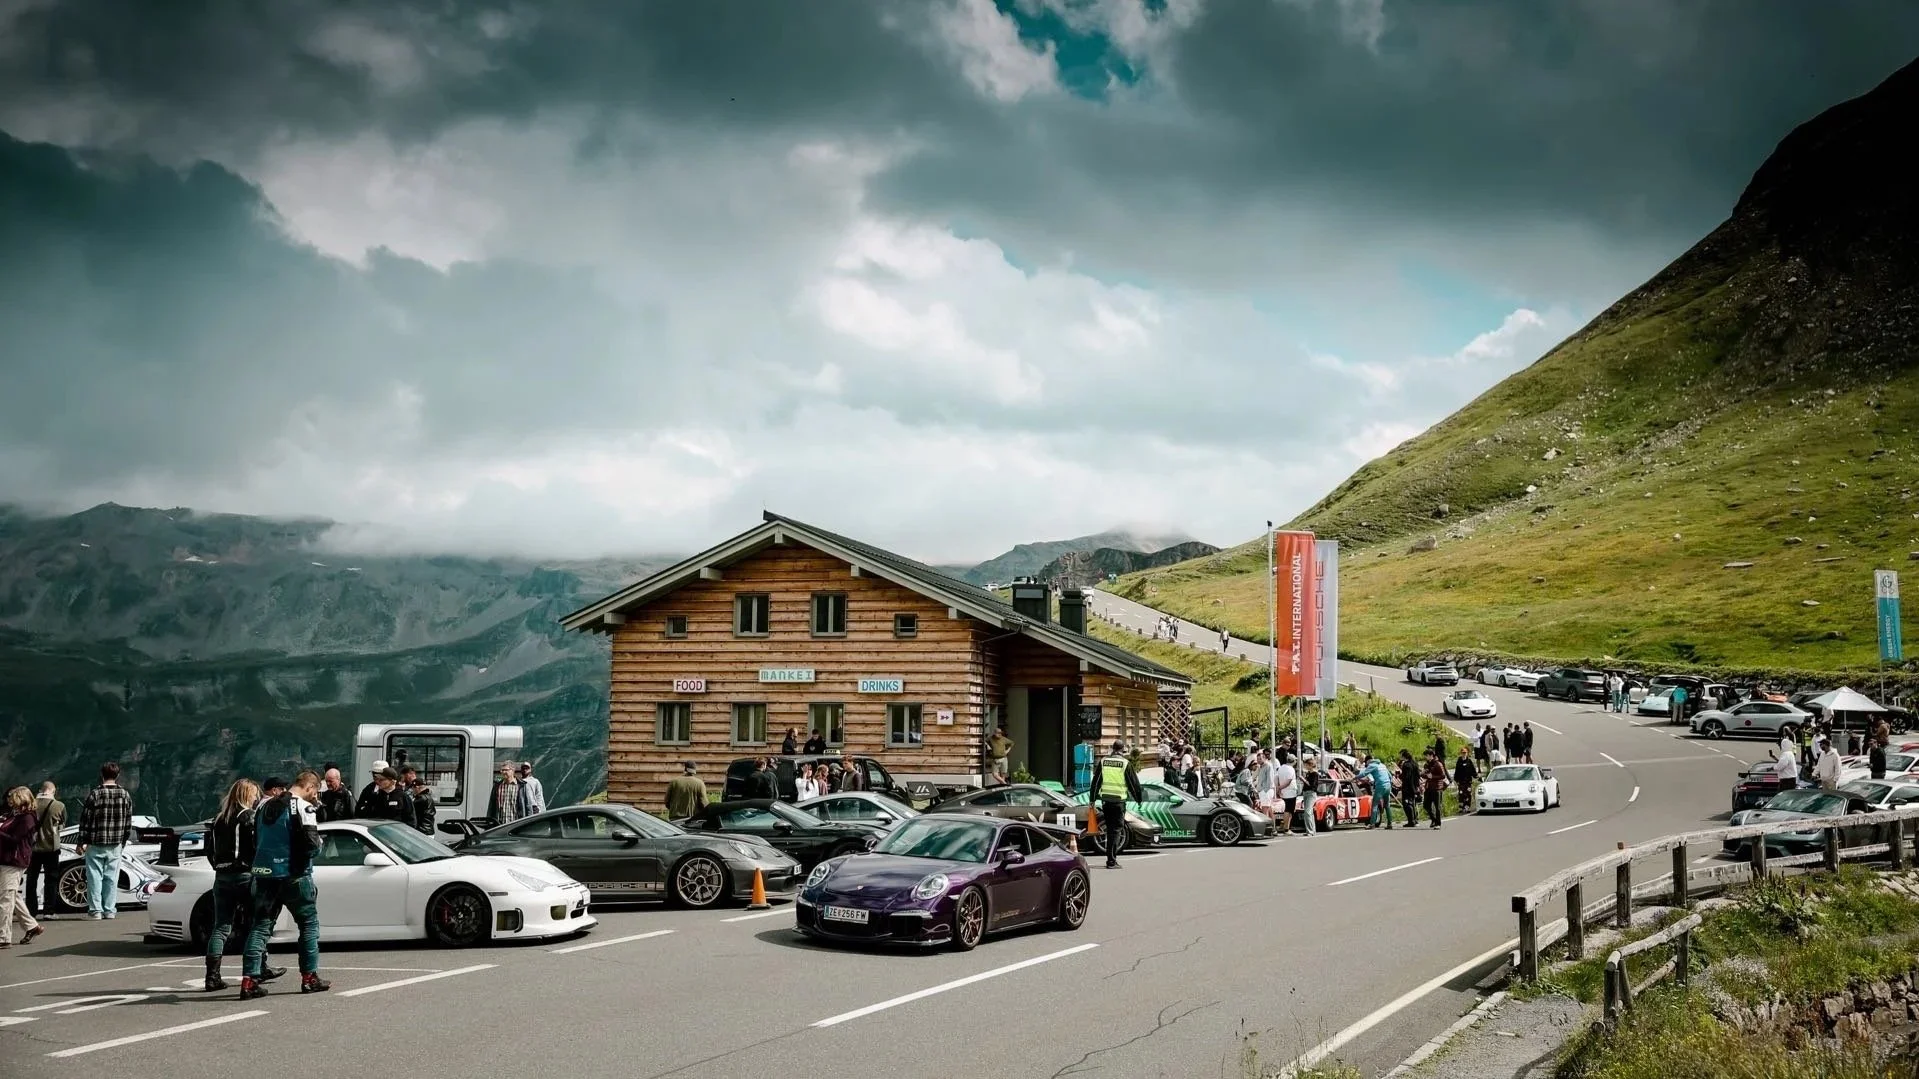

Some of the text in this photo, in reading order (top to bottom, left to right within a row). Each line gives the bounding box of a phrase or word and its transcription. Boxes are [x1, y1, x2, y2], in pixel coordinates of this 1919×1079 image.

[1292, 552, 1302, 640] INTERNATIONAL
[1315, 560, 1324, 679] PORSCHE
[676, 680, 703, 691] FOOD
[862, 680, 899, 691] DRINKS
[1062, 815, 1070, 826] 11
